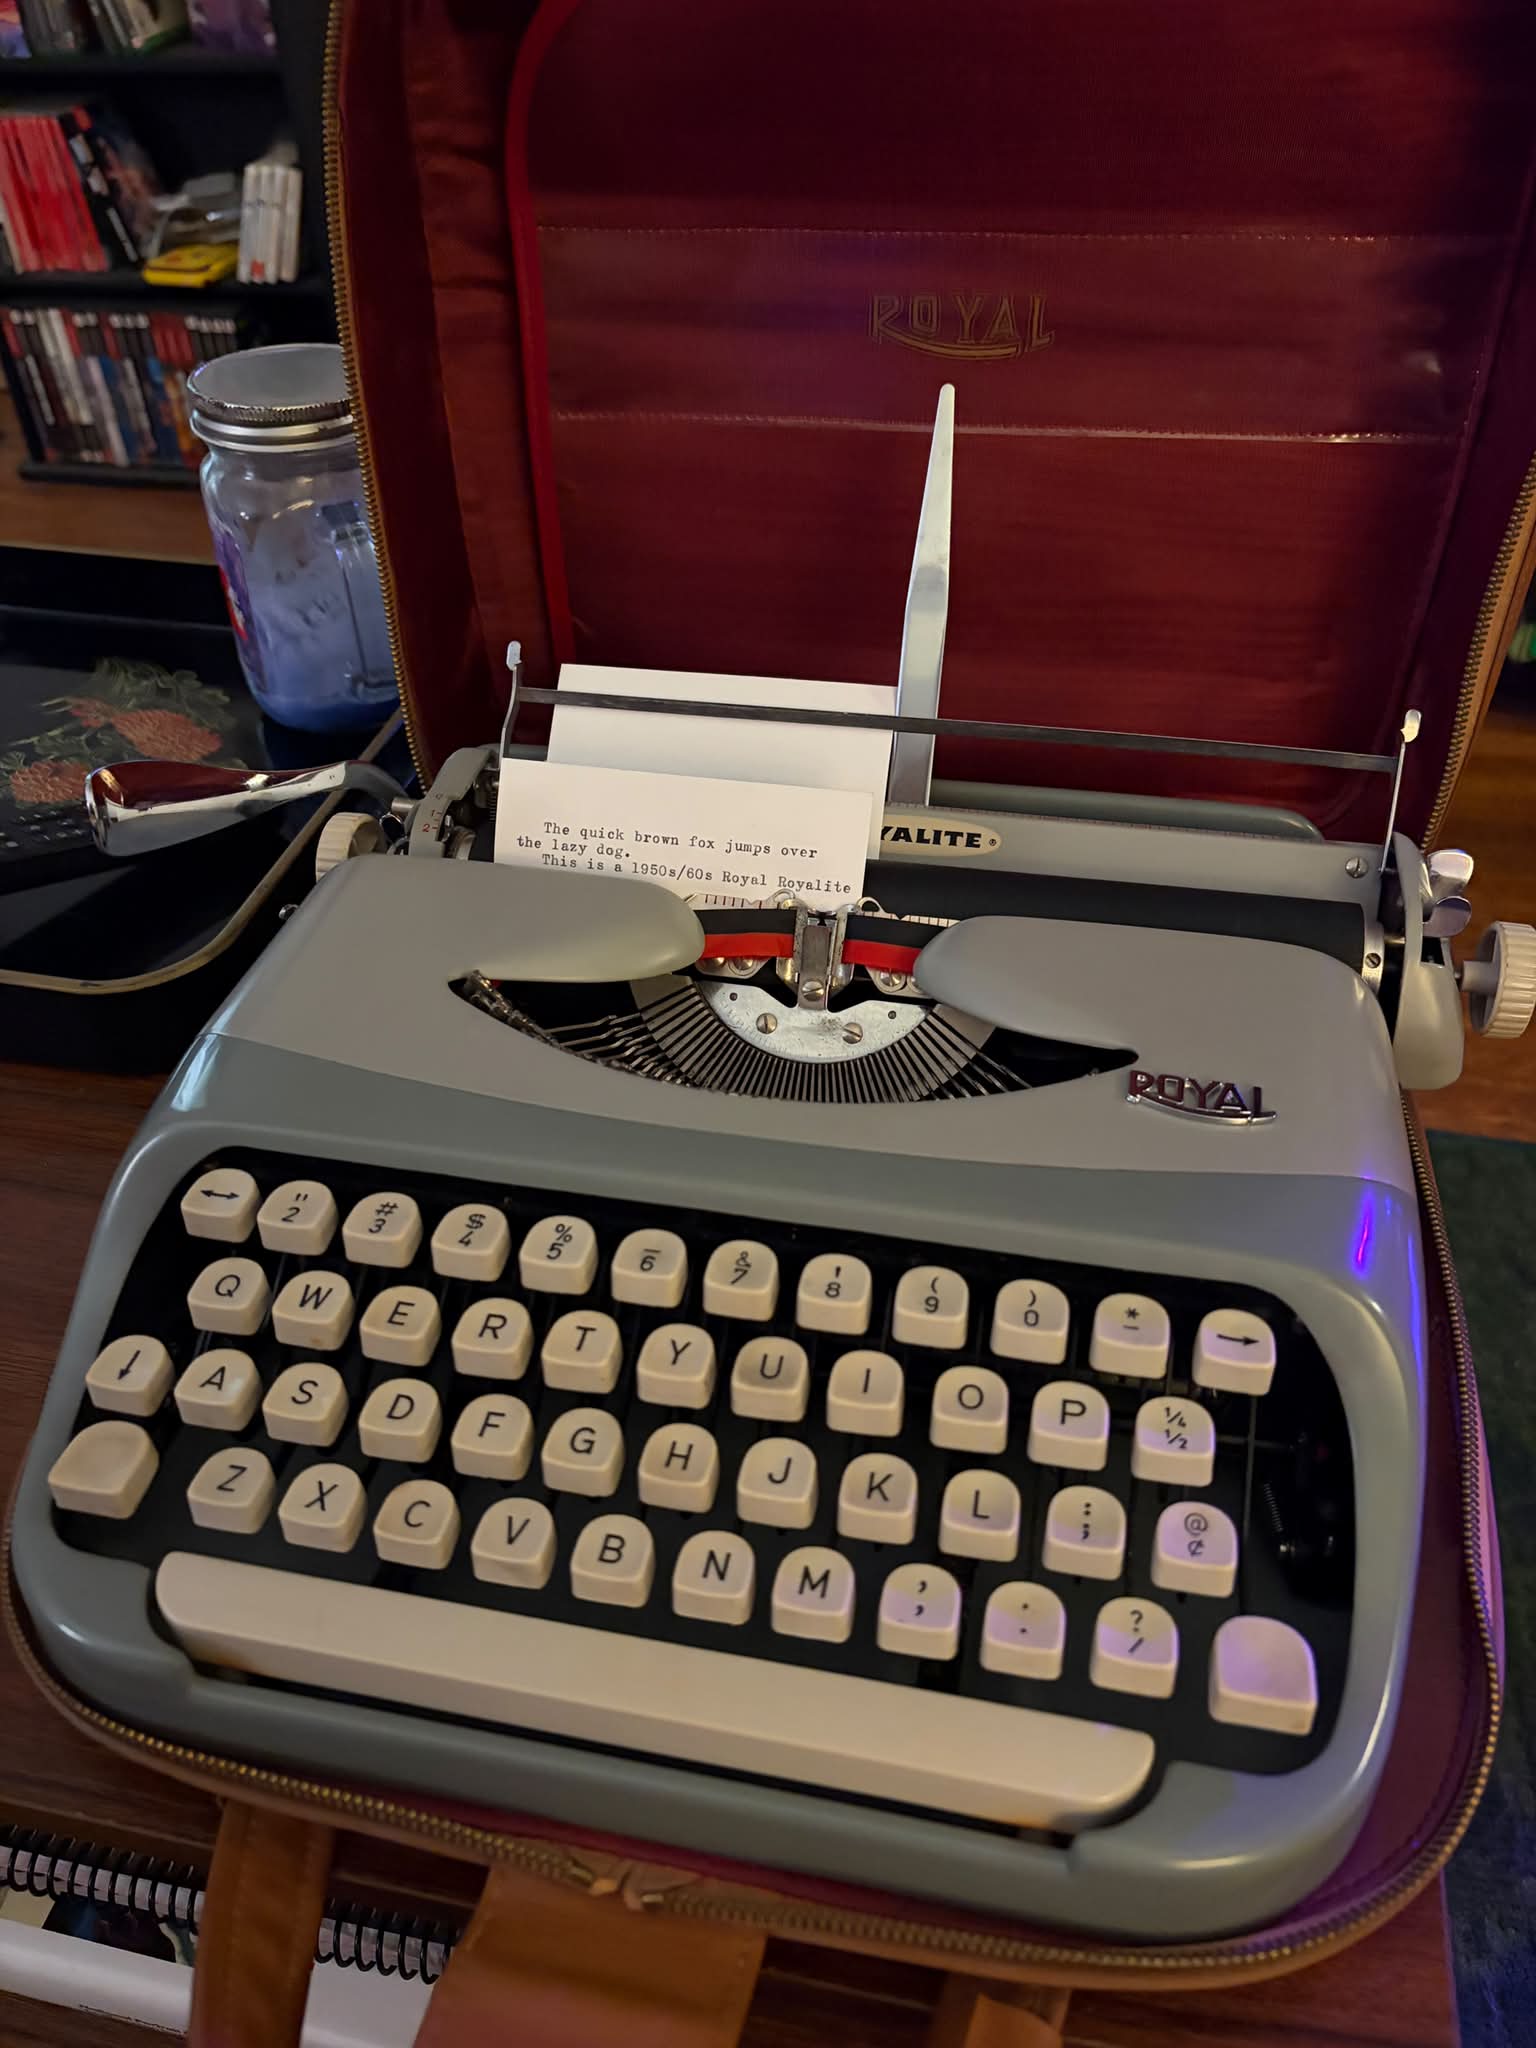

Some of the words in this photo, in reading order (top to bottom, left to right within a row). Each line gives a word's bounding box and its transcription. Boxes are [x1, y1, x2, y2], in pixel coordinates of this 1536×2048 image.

[867, 293, 1056, 359] ROYAL
[422, 823, 431, 833] 2
[543, 822, 570, 836] The
[580, 827, 625, 841] quick
[634, 831, 679, 846] brown
[689, 836, 715, 849] fox
[725, 839, 771, 856] jumps
[781, 846, 818, 859] over
[881, 826, 981, 848] YALITE
[517, 836, 542, 849] the
[551, 839, 588, 856] lazy
[596, 843, 631, 859] dog.
[542, 853, 577, 868] This
[587, 858, 604, 871] is
[614, 863, 624, 873] a
[632, 862, 713, 881] 1950s/60s
[722, 871, 767, 887] Royal
[778, 876, 851, 894] Royalite
[1126, 1069, 1278, 1126] ROYAL
[281, 1207, 300, 1223] 2
[375, 1201, 398, 1217] #
[465, 1214, 486, 1229] $
[368, 1218, 386, 1234] 3
[458, 1231, 475, 1247] 4
[555, 1223, 573, 1243] %
[546, 1243, 564, 1260] 5
[640, 1255, 656, 1271] 6
[735, 1251, 752, 1268] &
[215, 1274, 241, 1297] Q
[731, 1268, 748, 1285] 7
[298, 1284, 333, 1310] W
[825, 1282, 841, 1298] 8
[387, 1301, 415, 1326] E
[925, 1296, 939, 1313] 9
[478, 1313, 507, 1339] R
[575, 1325, 597, 1351] T
[670, 1339, 692, 1365] Y
[200, 1366, 227, 1391] A
[759, 1354, 784, 1380] U
[291, 1380, 319, 1405] S
[863, 1368, 871, 1394] I
[386, 1394, 415, 1420] D
[958, 1384, 984, 1410] O
[478, 1411, 506, 1438] F
[1060, 1398, 1086, 1425] P
[569, 1427, 597, 1454] G
[664, 1440, 694, 1470] H
[216, 1464, 248, 1492] Z
[768, 1457, 792, 1484] J
[304, 1480, 339, 1511] X
[866, 1471, 894, 1502] K
[404, 1500, 432, 1528] C
[972, 1489, 990, 1519] L
[506, 1515, 531, 1545] V
[1183, 1512, 1209, 1536] @
[597, 1534, 626, 1564] B
[702, 1550, 731, 1581] N
[798, 1565, 831, 1599] M
[1130, 1609, 1144, 1633] ?
